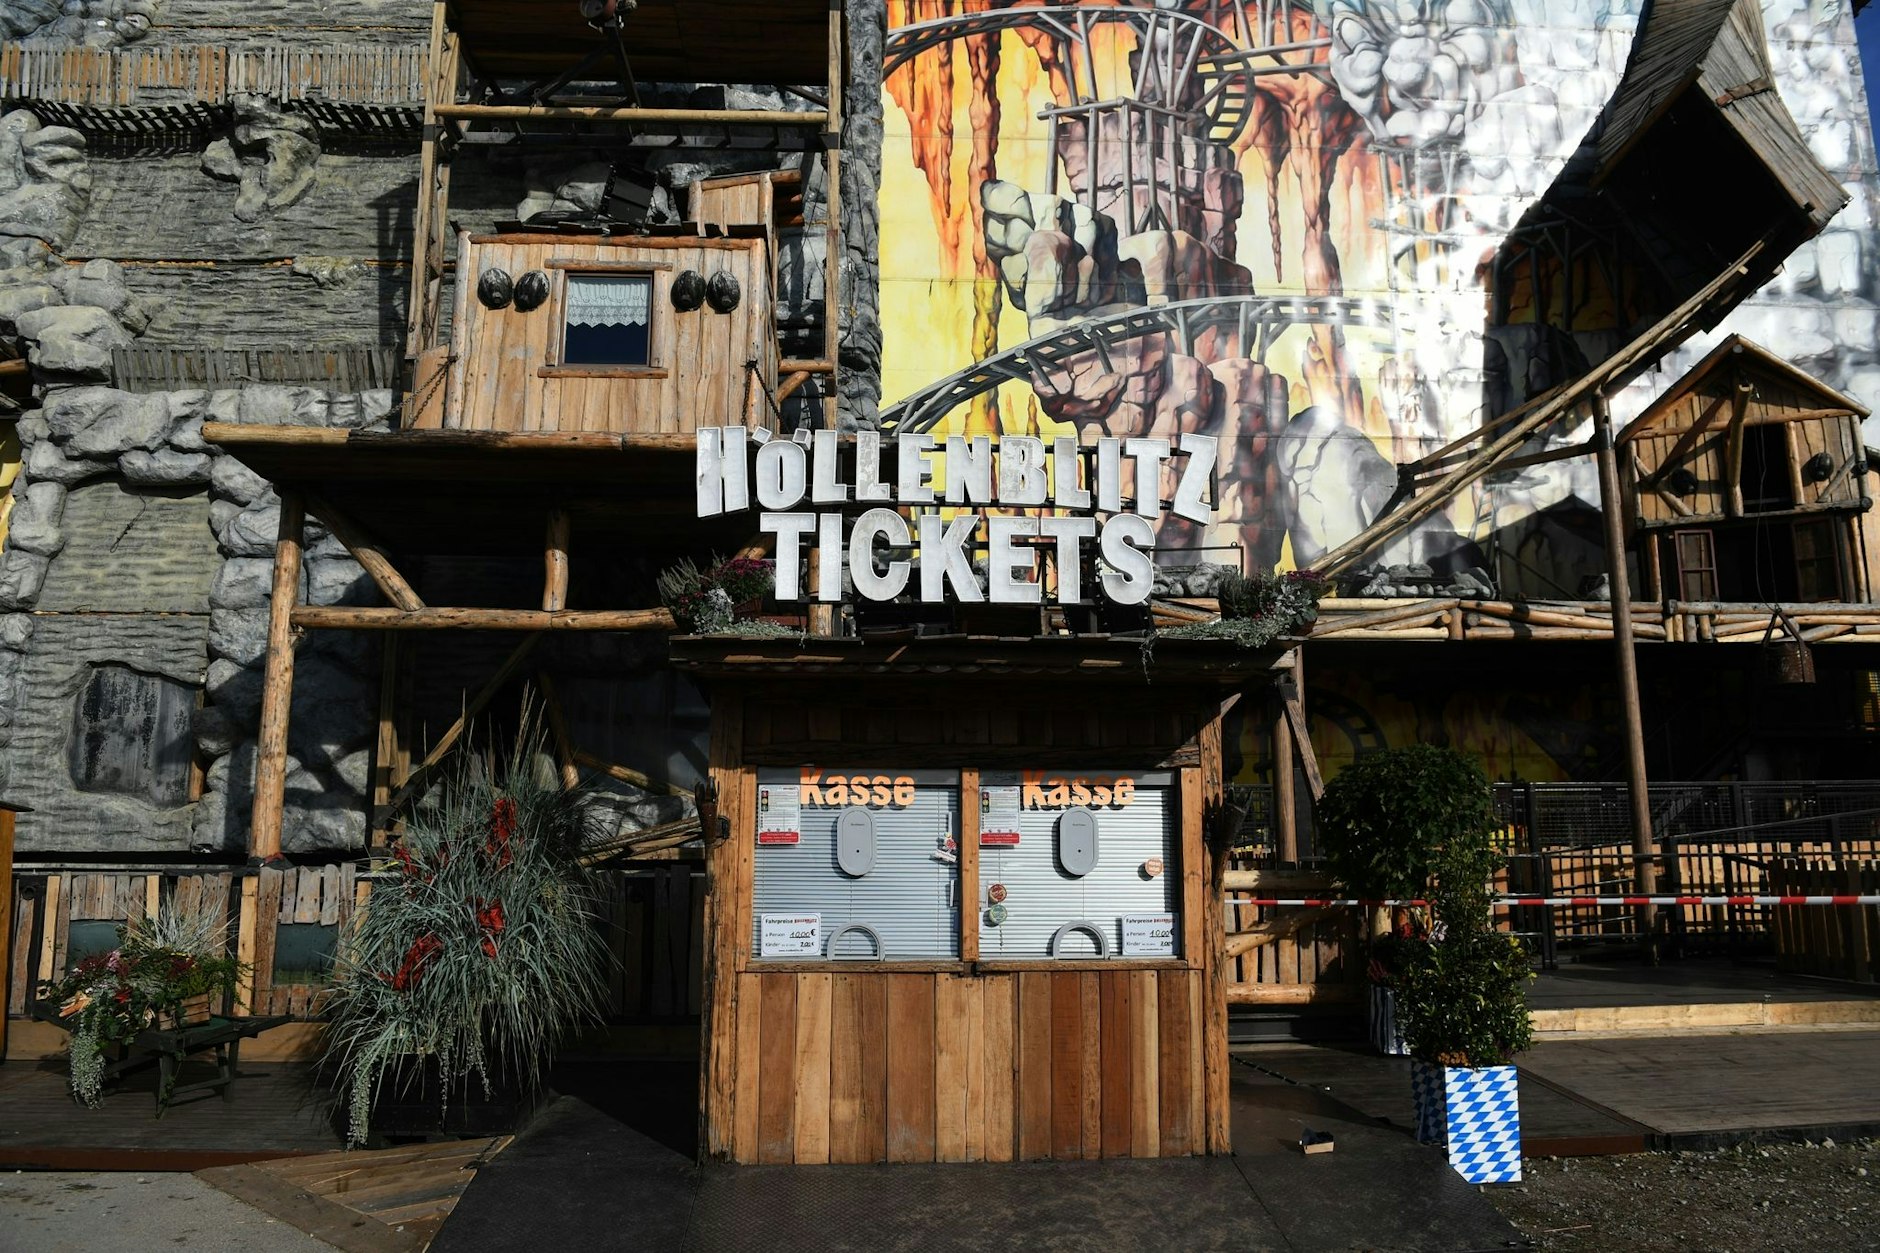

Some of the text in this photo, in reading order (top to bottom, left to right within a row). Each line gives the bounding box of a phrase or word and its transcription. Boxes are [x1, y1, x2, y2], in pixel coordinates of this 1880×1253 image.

[696, 427, 1218, 526] HÖLLENBLITZ
[760, 508, 1156, 605] TICKETS
[800, 767, 915, 806] Kasse
[1023, 769, 1135, 808] Kasse
